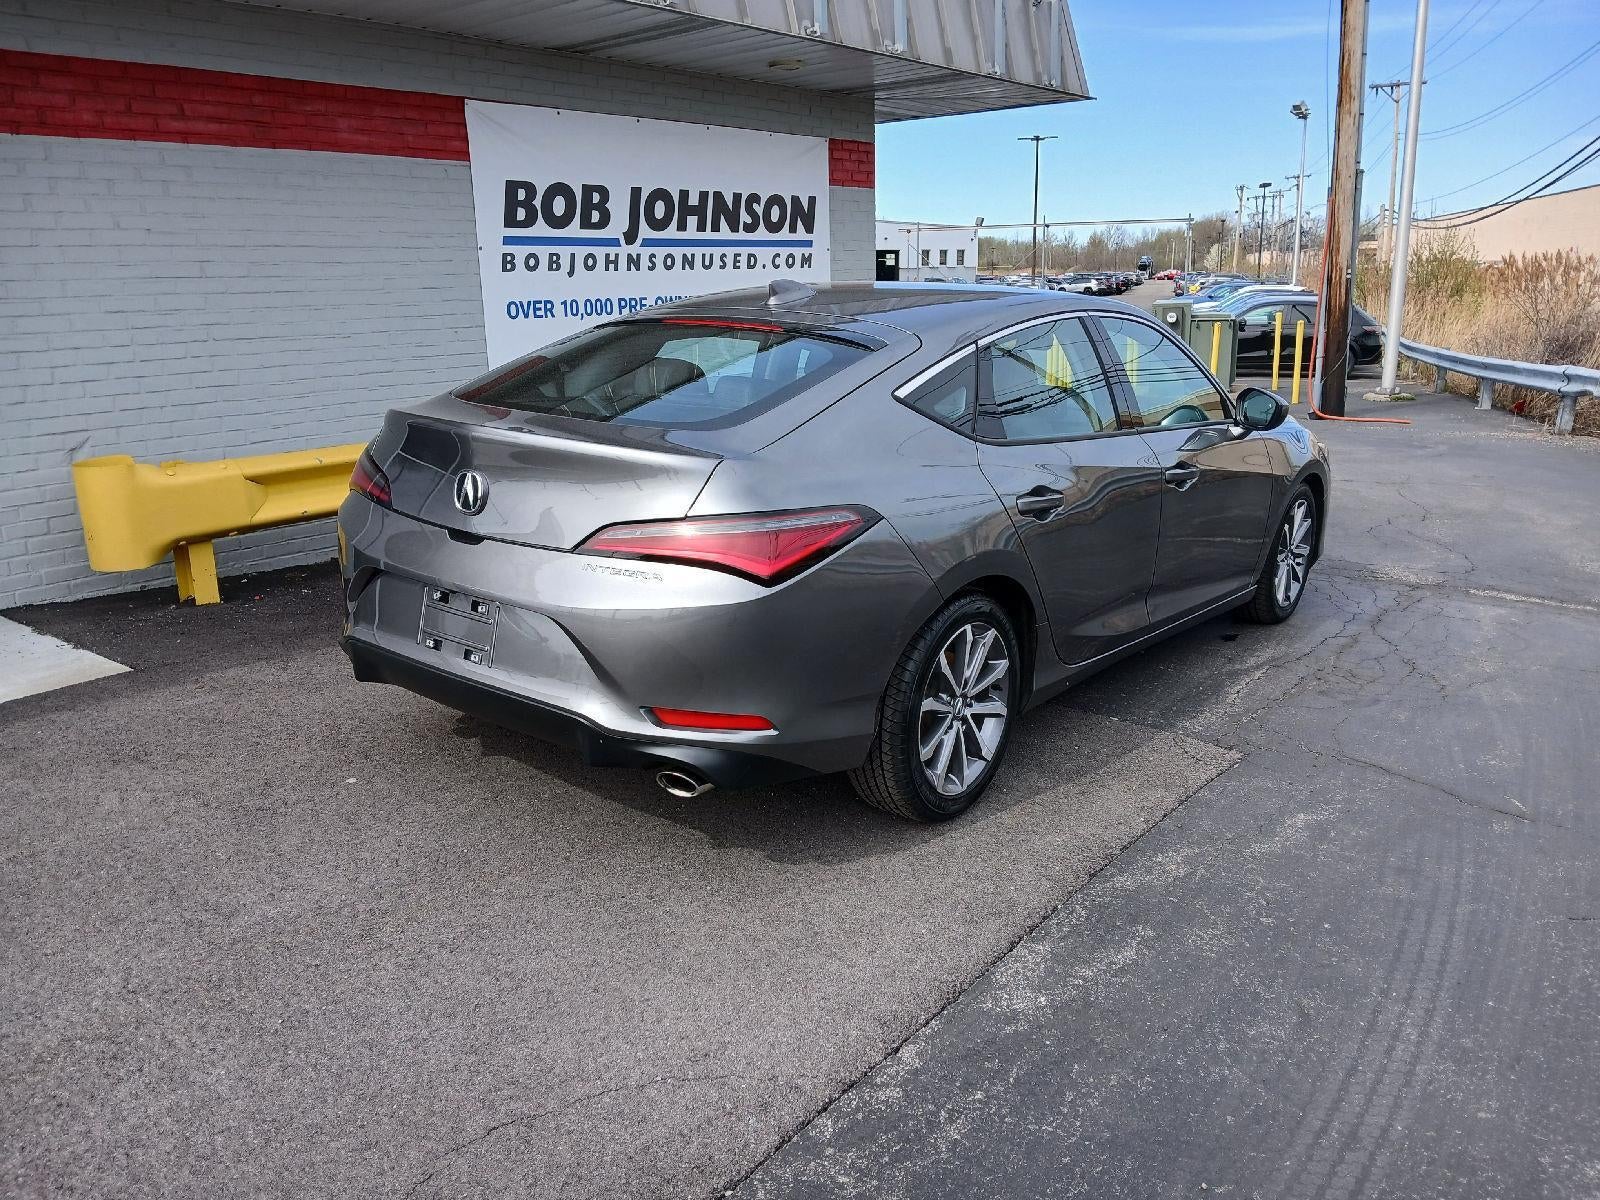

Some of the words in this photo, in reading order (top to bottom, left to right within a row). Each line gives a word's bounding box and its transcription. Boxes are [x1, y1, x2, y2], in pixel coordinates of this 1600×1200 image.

[503, 180, 611, 230] BOB
[622, 186, 817, 245] JOHNSON
[501, 252, 813, 278] BOBJOHNSONUSED.COM
[506, 299, 555, 320] OVER
[560, 297, 614, 321] 10,000
